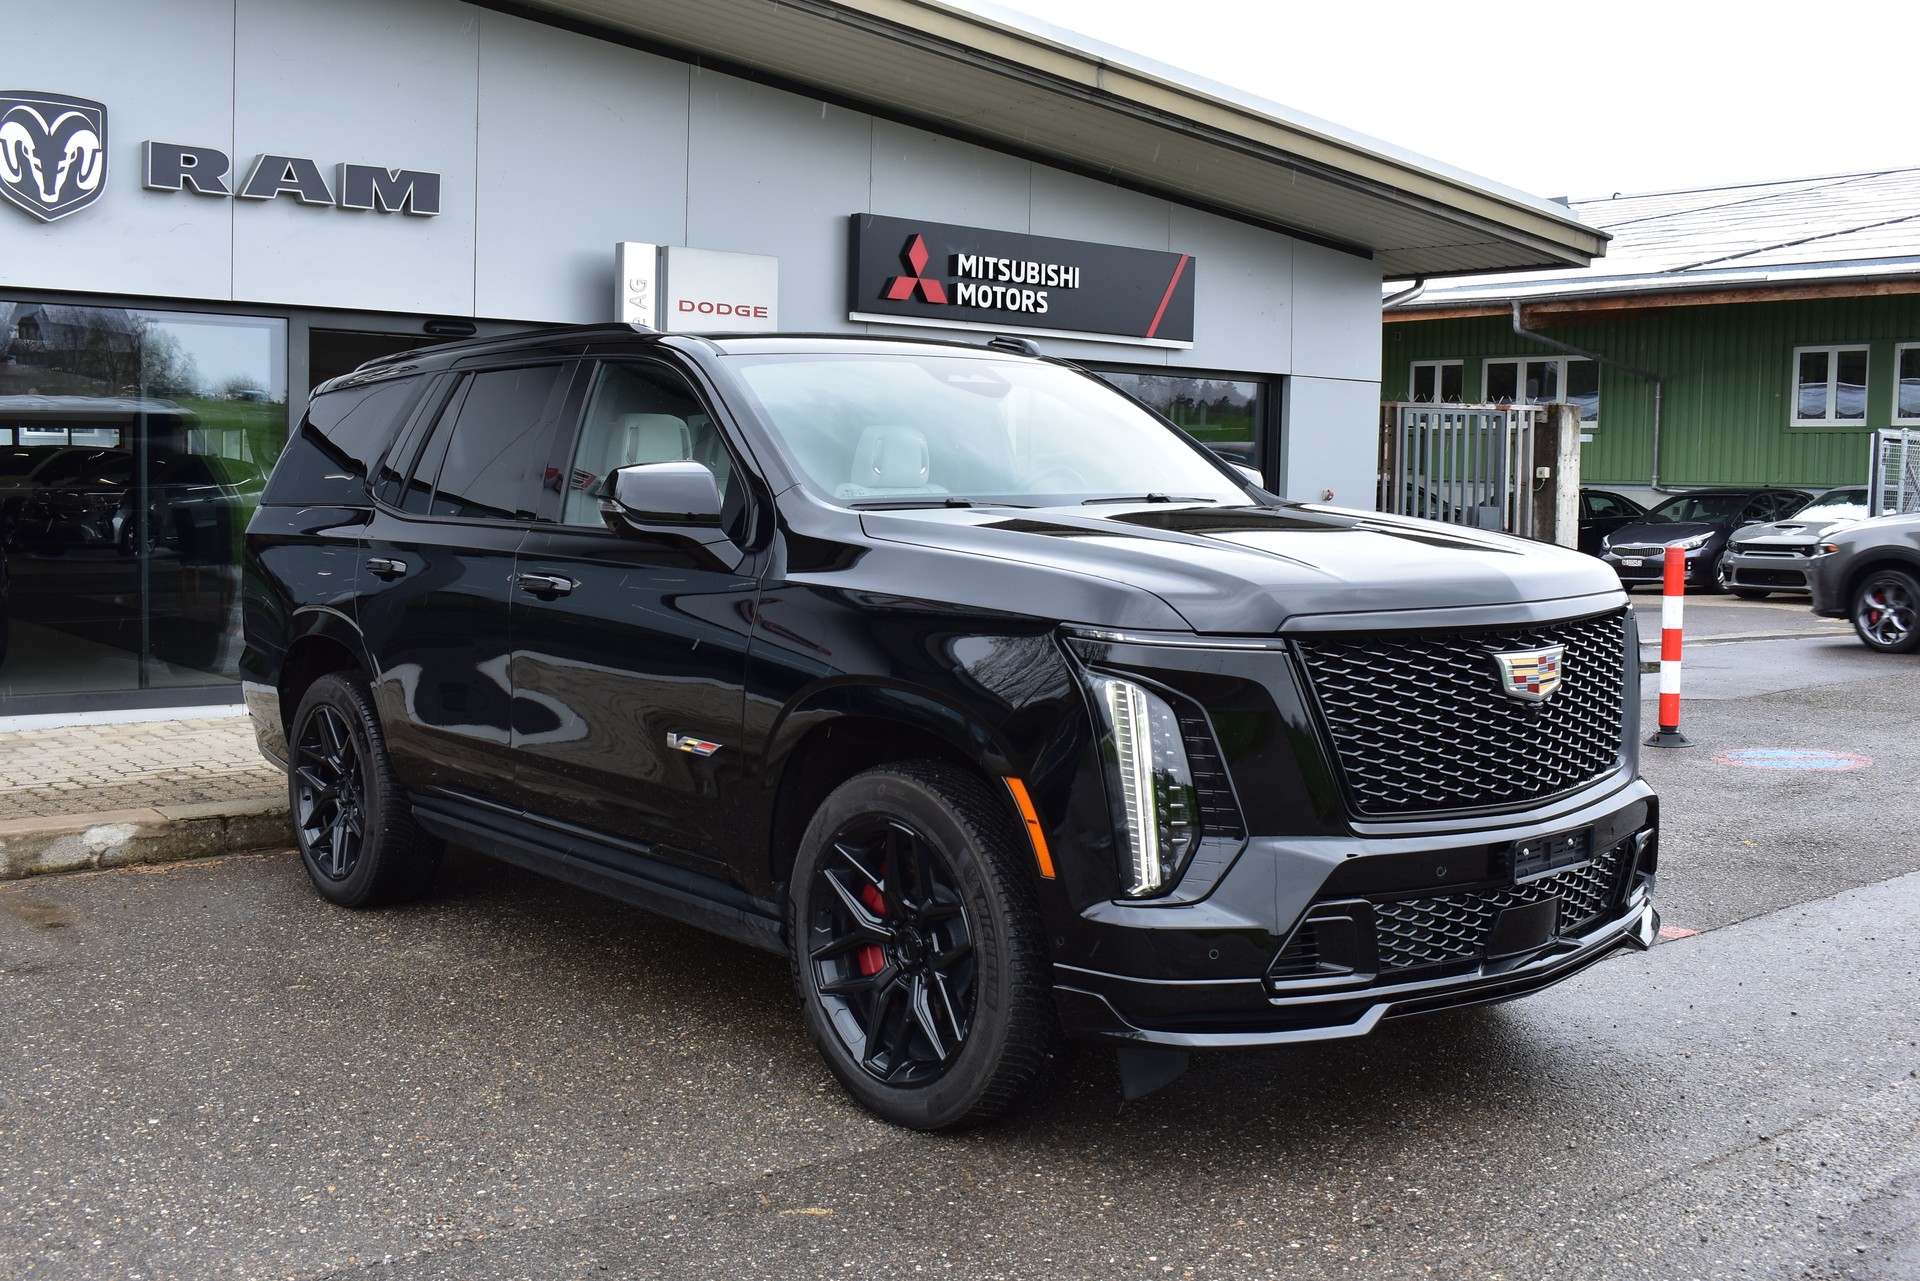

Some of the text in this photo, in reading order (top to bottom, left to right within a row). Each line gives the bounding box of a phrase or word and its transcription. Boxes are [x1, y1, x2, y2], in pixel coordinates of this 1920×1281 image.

[142, 139, 441, 217] RAM
[957, 253, 1081, 289] MITSUBISHI
[629, 278, 647, 310] AG
[678, 299, 768, 319] DODGE
[957, 282, 1049, 314] MOTORS
[975, 896, 999, 1008] MICHELIN
